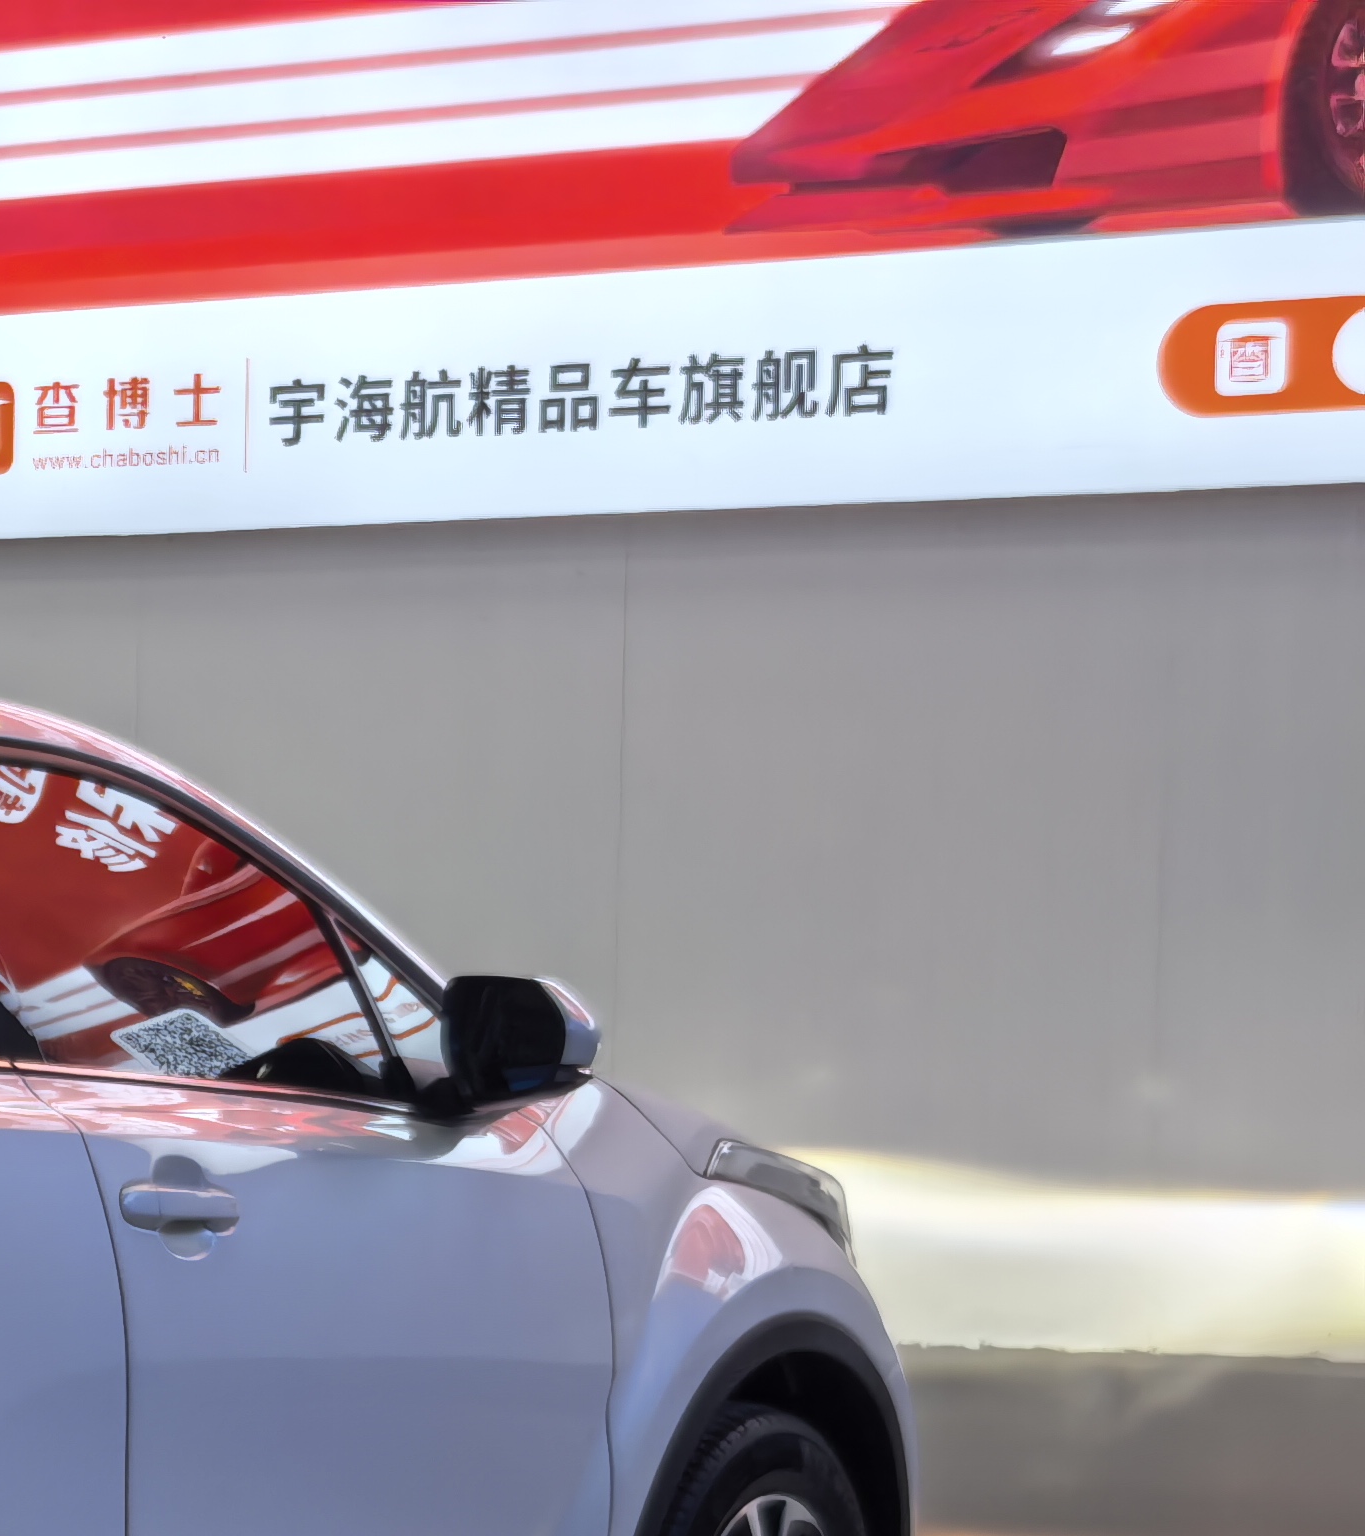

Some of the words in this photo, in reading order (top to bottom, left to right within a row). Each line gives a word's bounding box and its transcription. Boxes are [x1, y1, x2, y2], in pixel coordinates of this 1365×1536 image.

[32, 372, 222, 435] 查博士
[267, 342, 896, 449] 宇海航精品车旗舰店
[32, 445, 221, 470] www.chaboshi.cn
